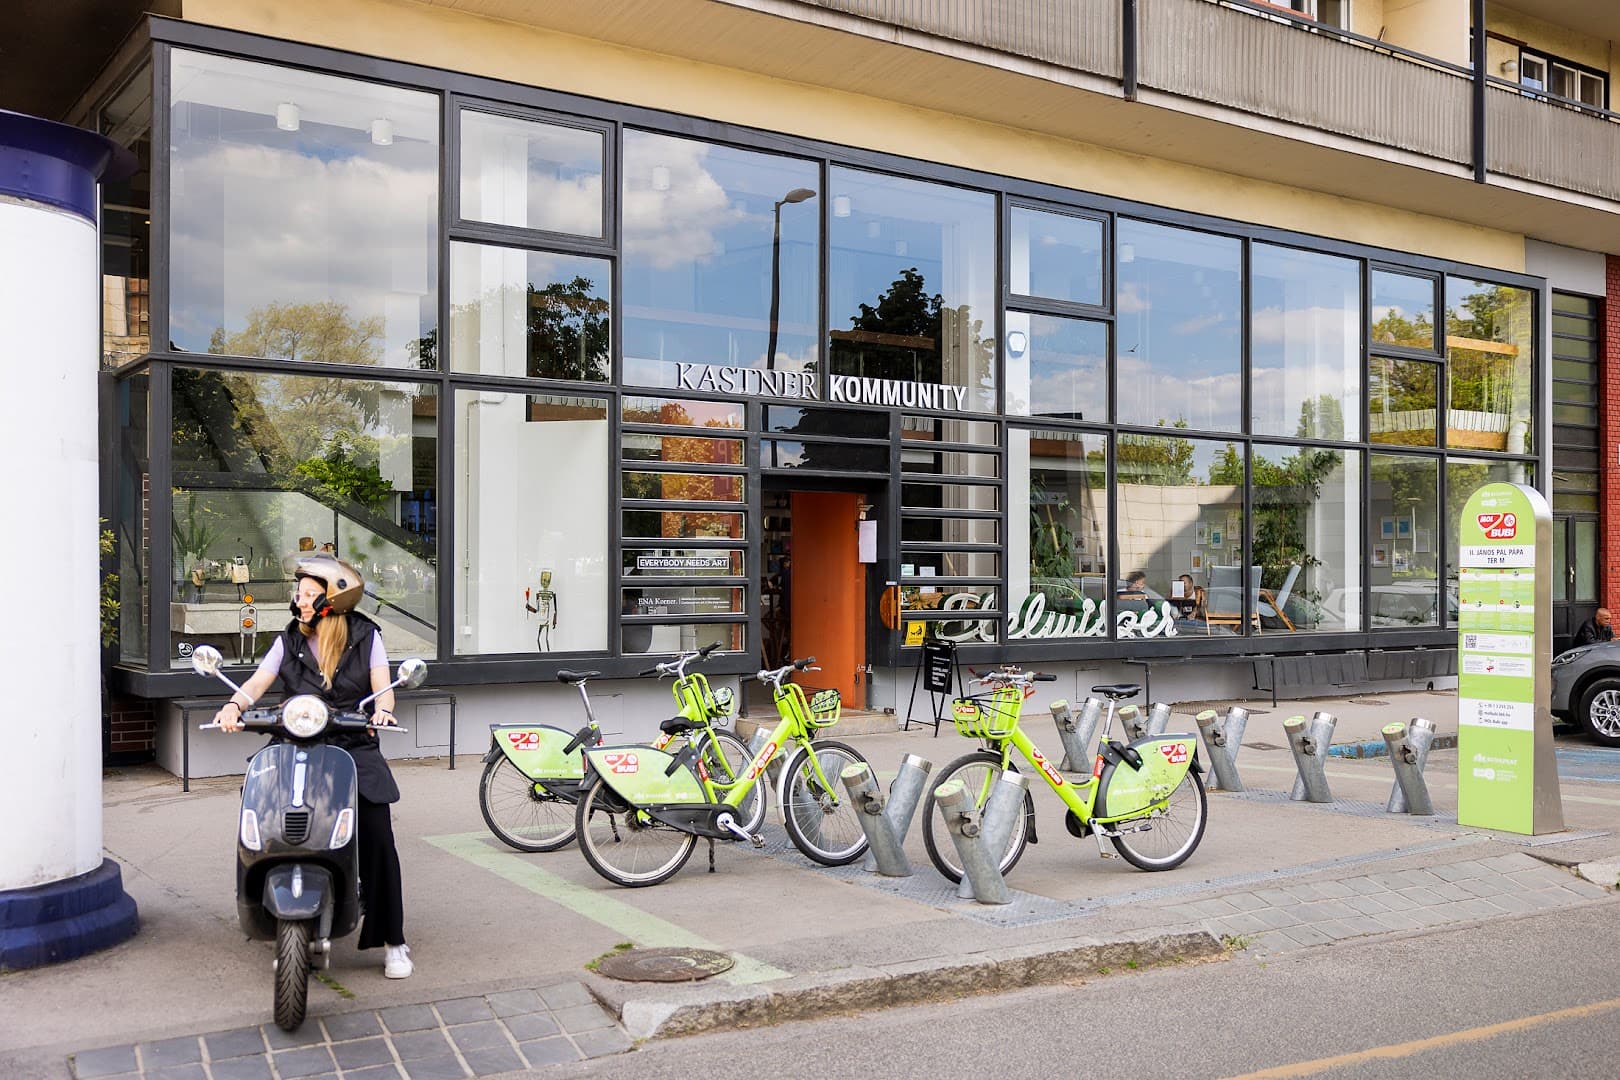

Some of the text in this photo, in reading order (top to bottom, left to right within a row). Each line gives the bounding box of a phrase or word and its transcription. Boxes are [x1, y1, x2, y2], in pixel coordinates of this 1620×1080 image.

[675, 362, 967, 411] KASTNER KOMMUNITY
[1491, 528, 1515, 537] BUBI
[640, 559, 727, 567] EVERYBODY NEEDS ART
